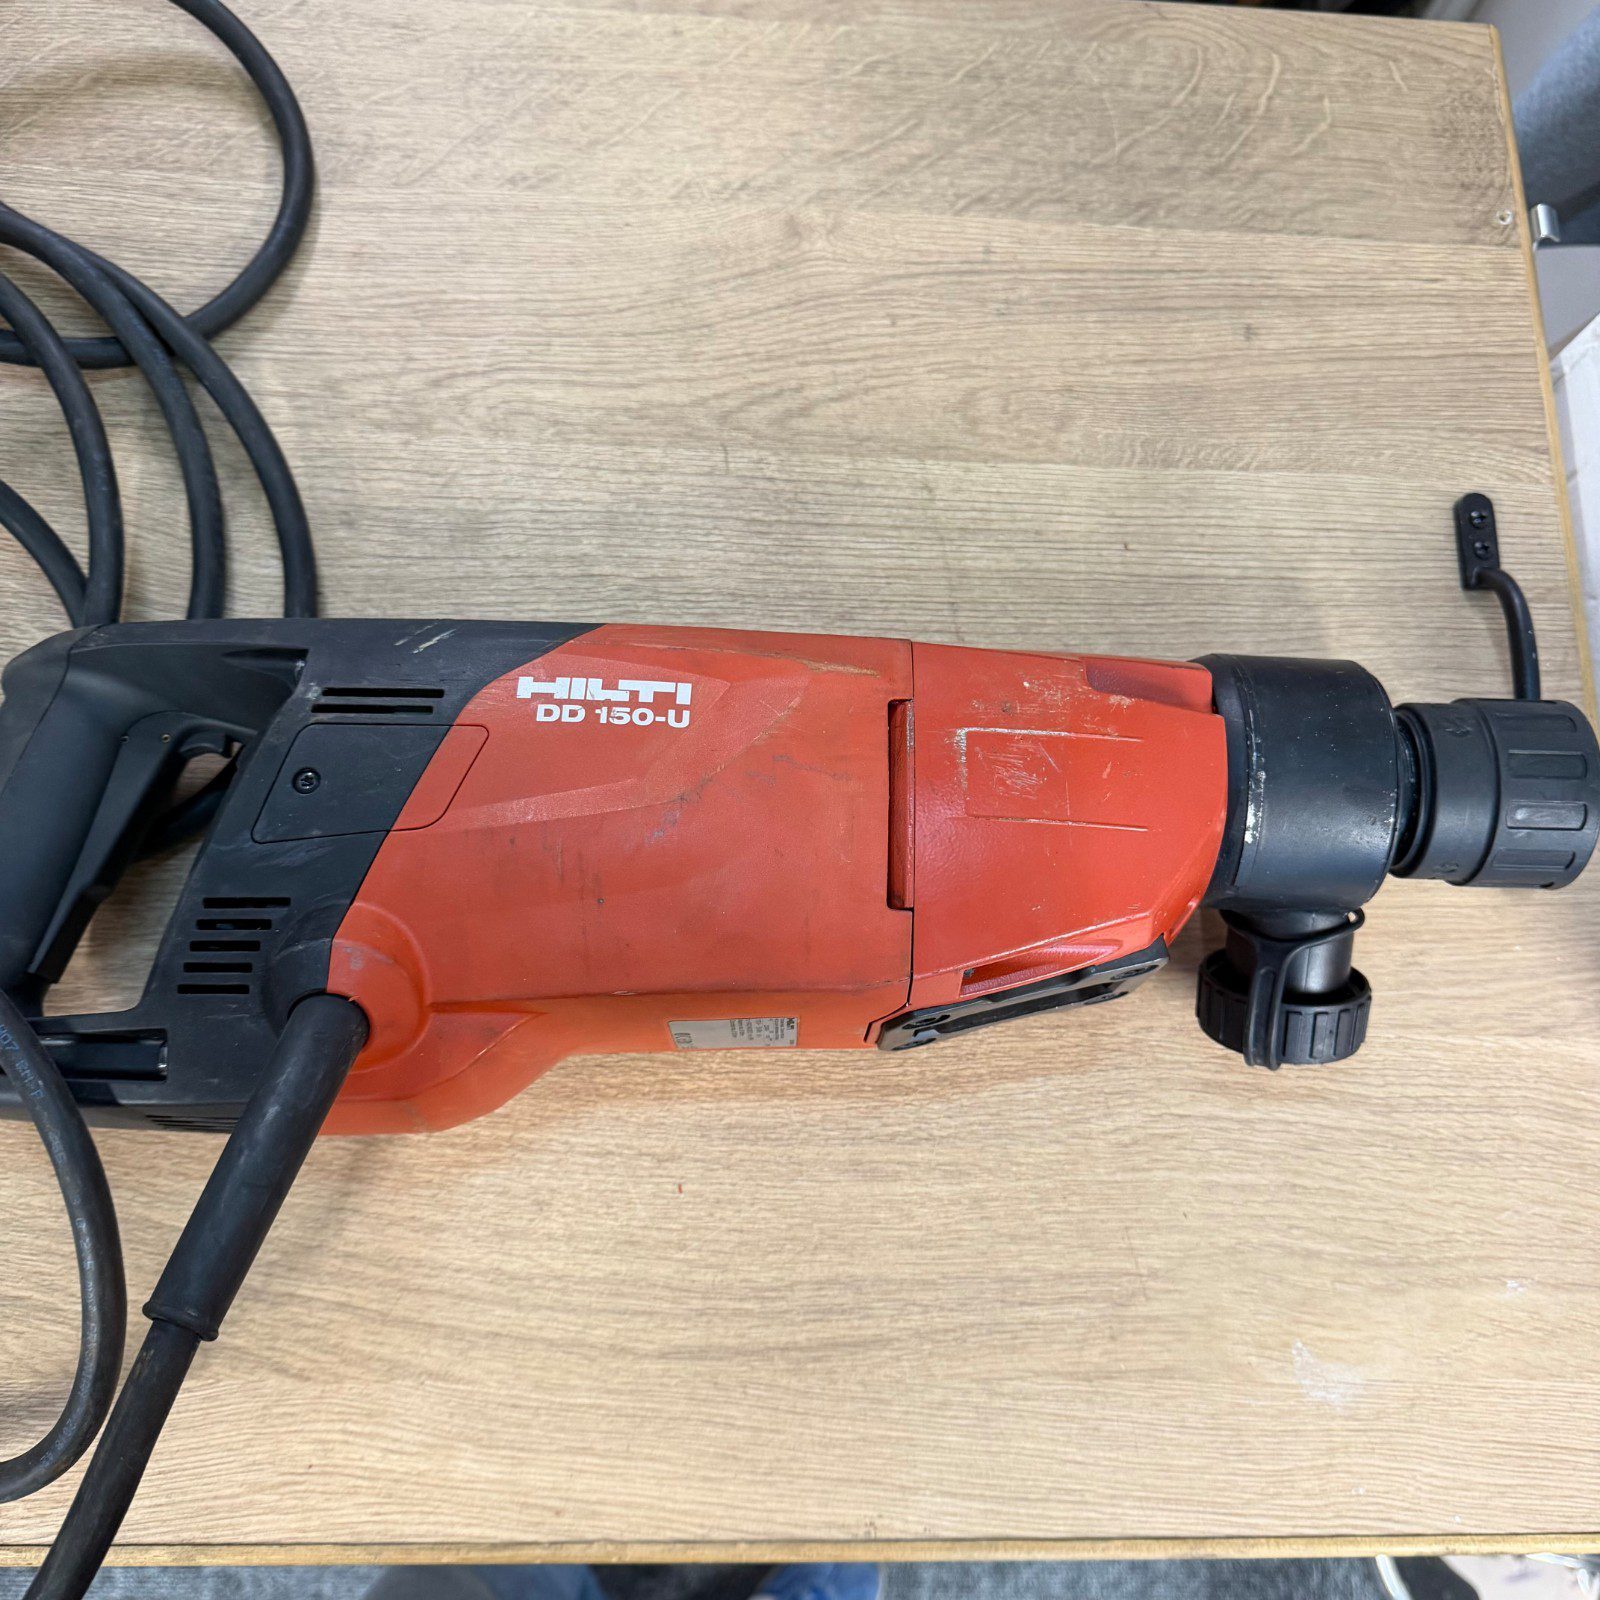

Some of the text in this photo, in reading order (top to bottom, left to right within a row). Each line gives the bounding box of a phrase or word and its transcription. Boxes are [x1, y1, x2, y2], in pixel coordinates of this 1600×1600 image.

[517, 676, 692, 705] HILTI
[536, 704, 690, 729] DD 150-U
